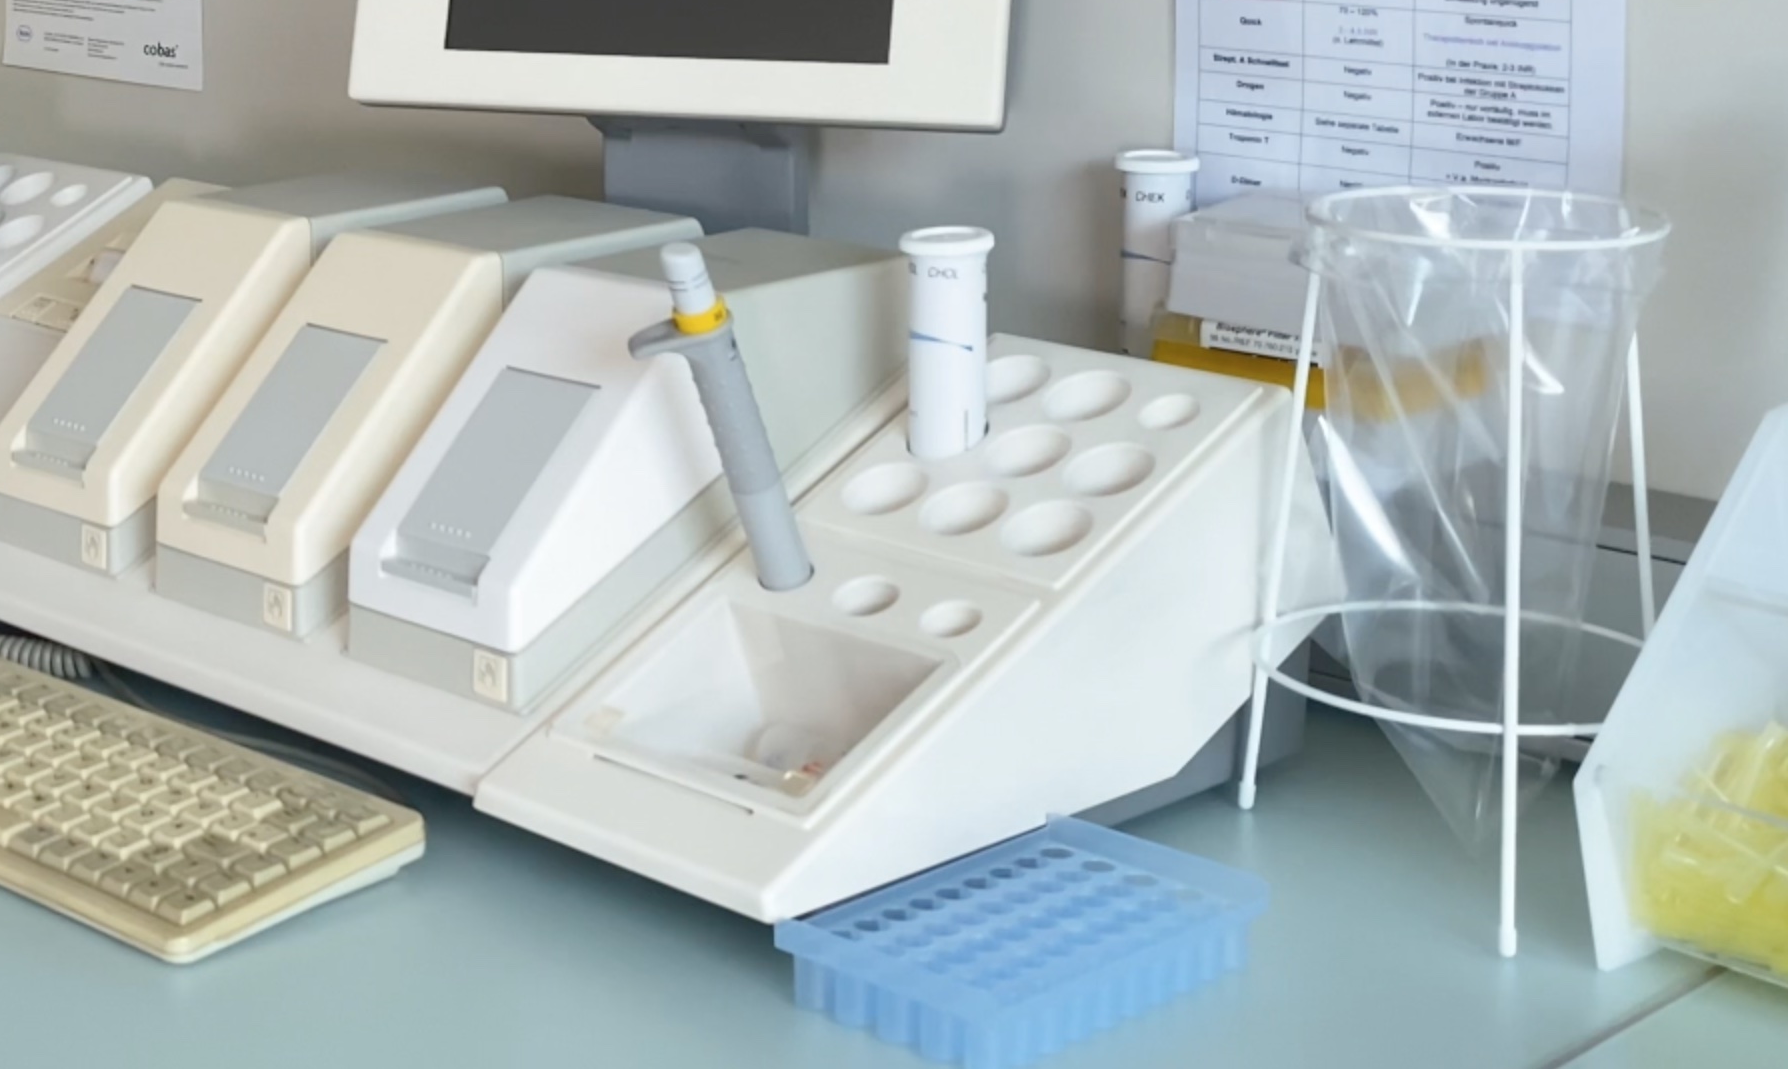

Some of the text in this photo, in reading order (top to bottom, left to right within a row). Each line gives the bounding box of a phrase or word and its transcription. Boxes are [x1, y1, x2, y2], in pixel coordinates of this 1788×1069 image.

[1240, 16, 1262, 26] Quick
[1458, 60, 1471, 68] der
[1344, 66, 1372, 76] Negativ
[1418, 72, 1443, 83] Positiv
[1236, 80, 1265, 91] Drogen
[1344, 91, 1372, 101] Negativ
[1479, 88, 1509, 100] Gruppe
[1226, 108, 1273, 121] Hämatologie
[1462, 112, 1485, 123] Labor
[1315, 117, 1336, 127] Siehe
[1372, 123, 1399, 134] Tabelle
[1455, 132, 1504, 145] Erwachsene
[1341, 145, 1369, 156] Negativ
[1135, 191, 1165, 203] CHEK
